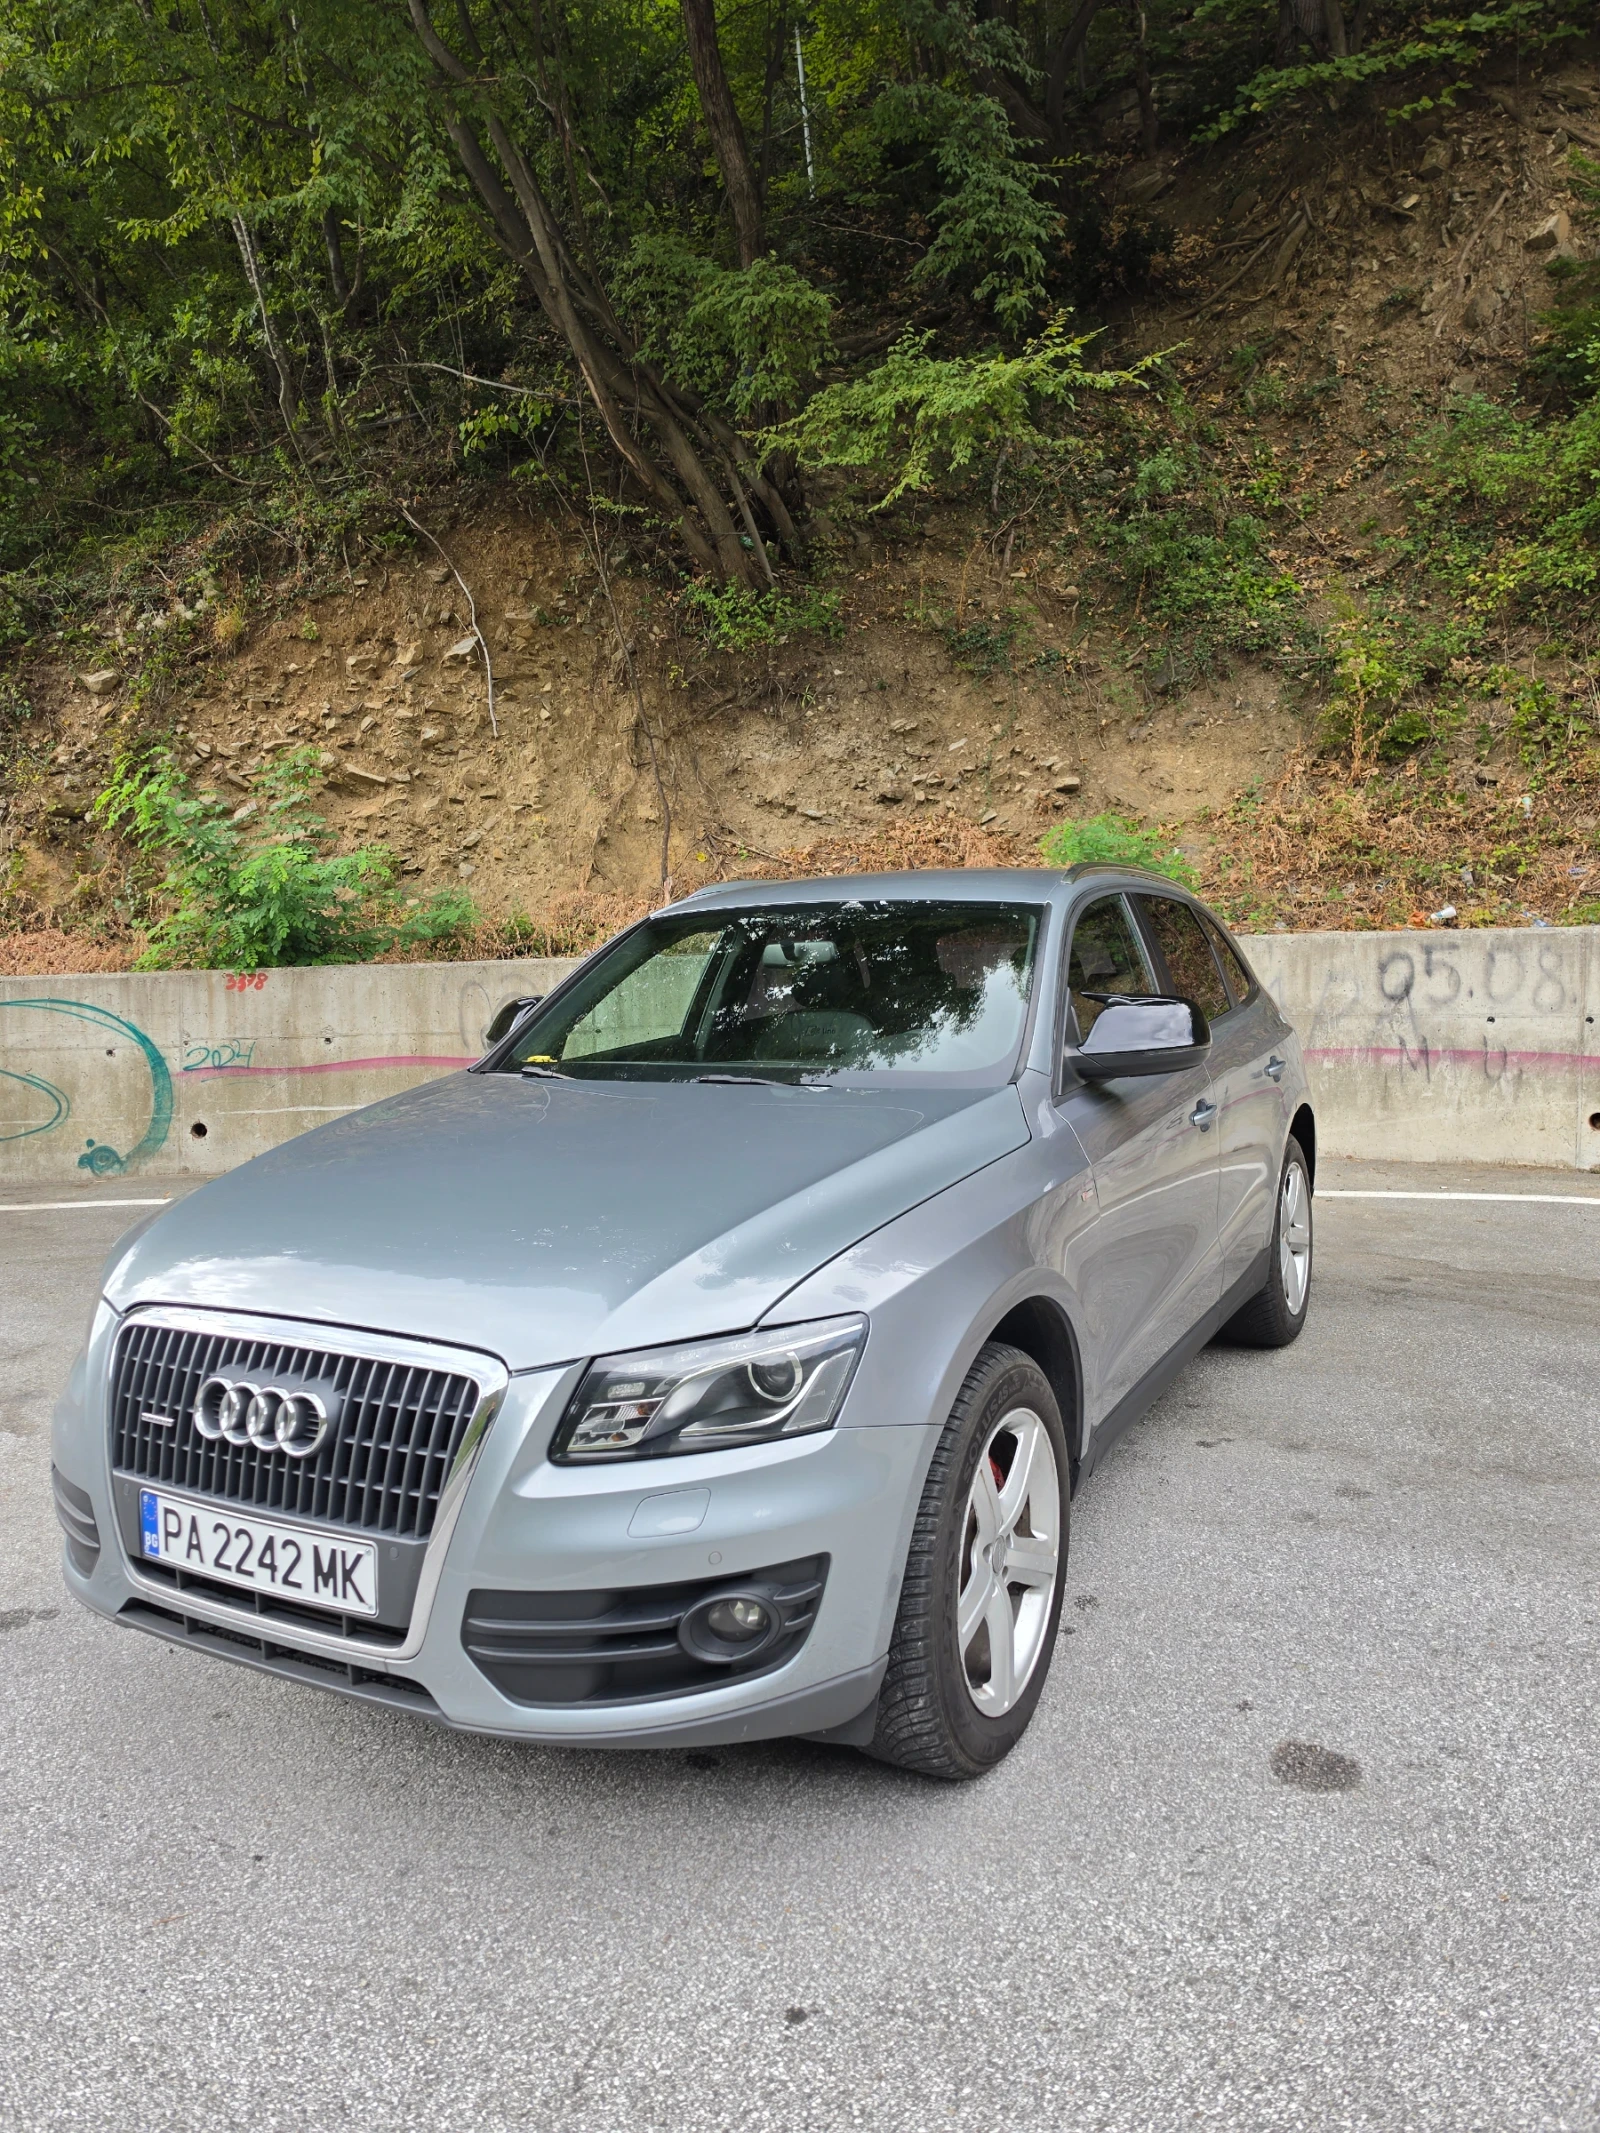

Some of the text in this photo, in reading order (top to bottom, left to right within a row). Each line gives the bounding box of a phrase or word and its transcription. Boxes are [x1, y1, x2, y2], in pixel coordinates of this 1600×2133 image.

[183, 1039, 256, 1071] 2024
[962, 1400, 1000, 1484] SOLUS
[143, 1531, 159, 1549] BG
[163, 1506, 367, 1605] PA 2242 MK
